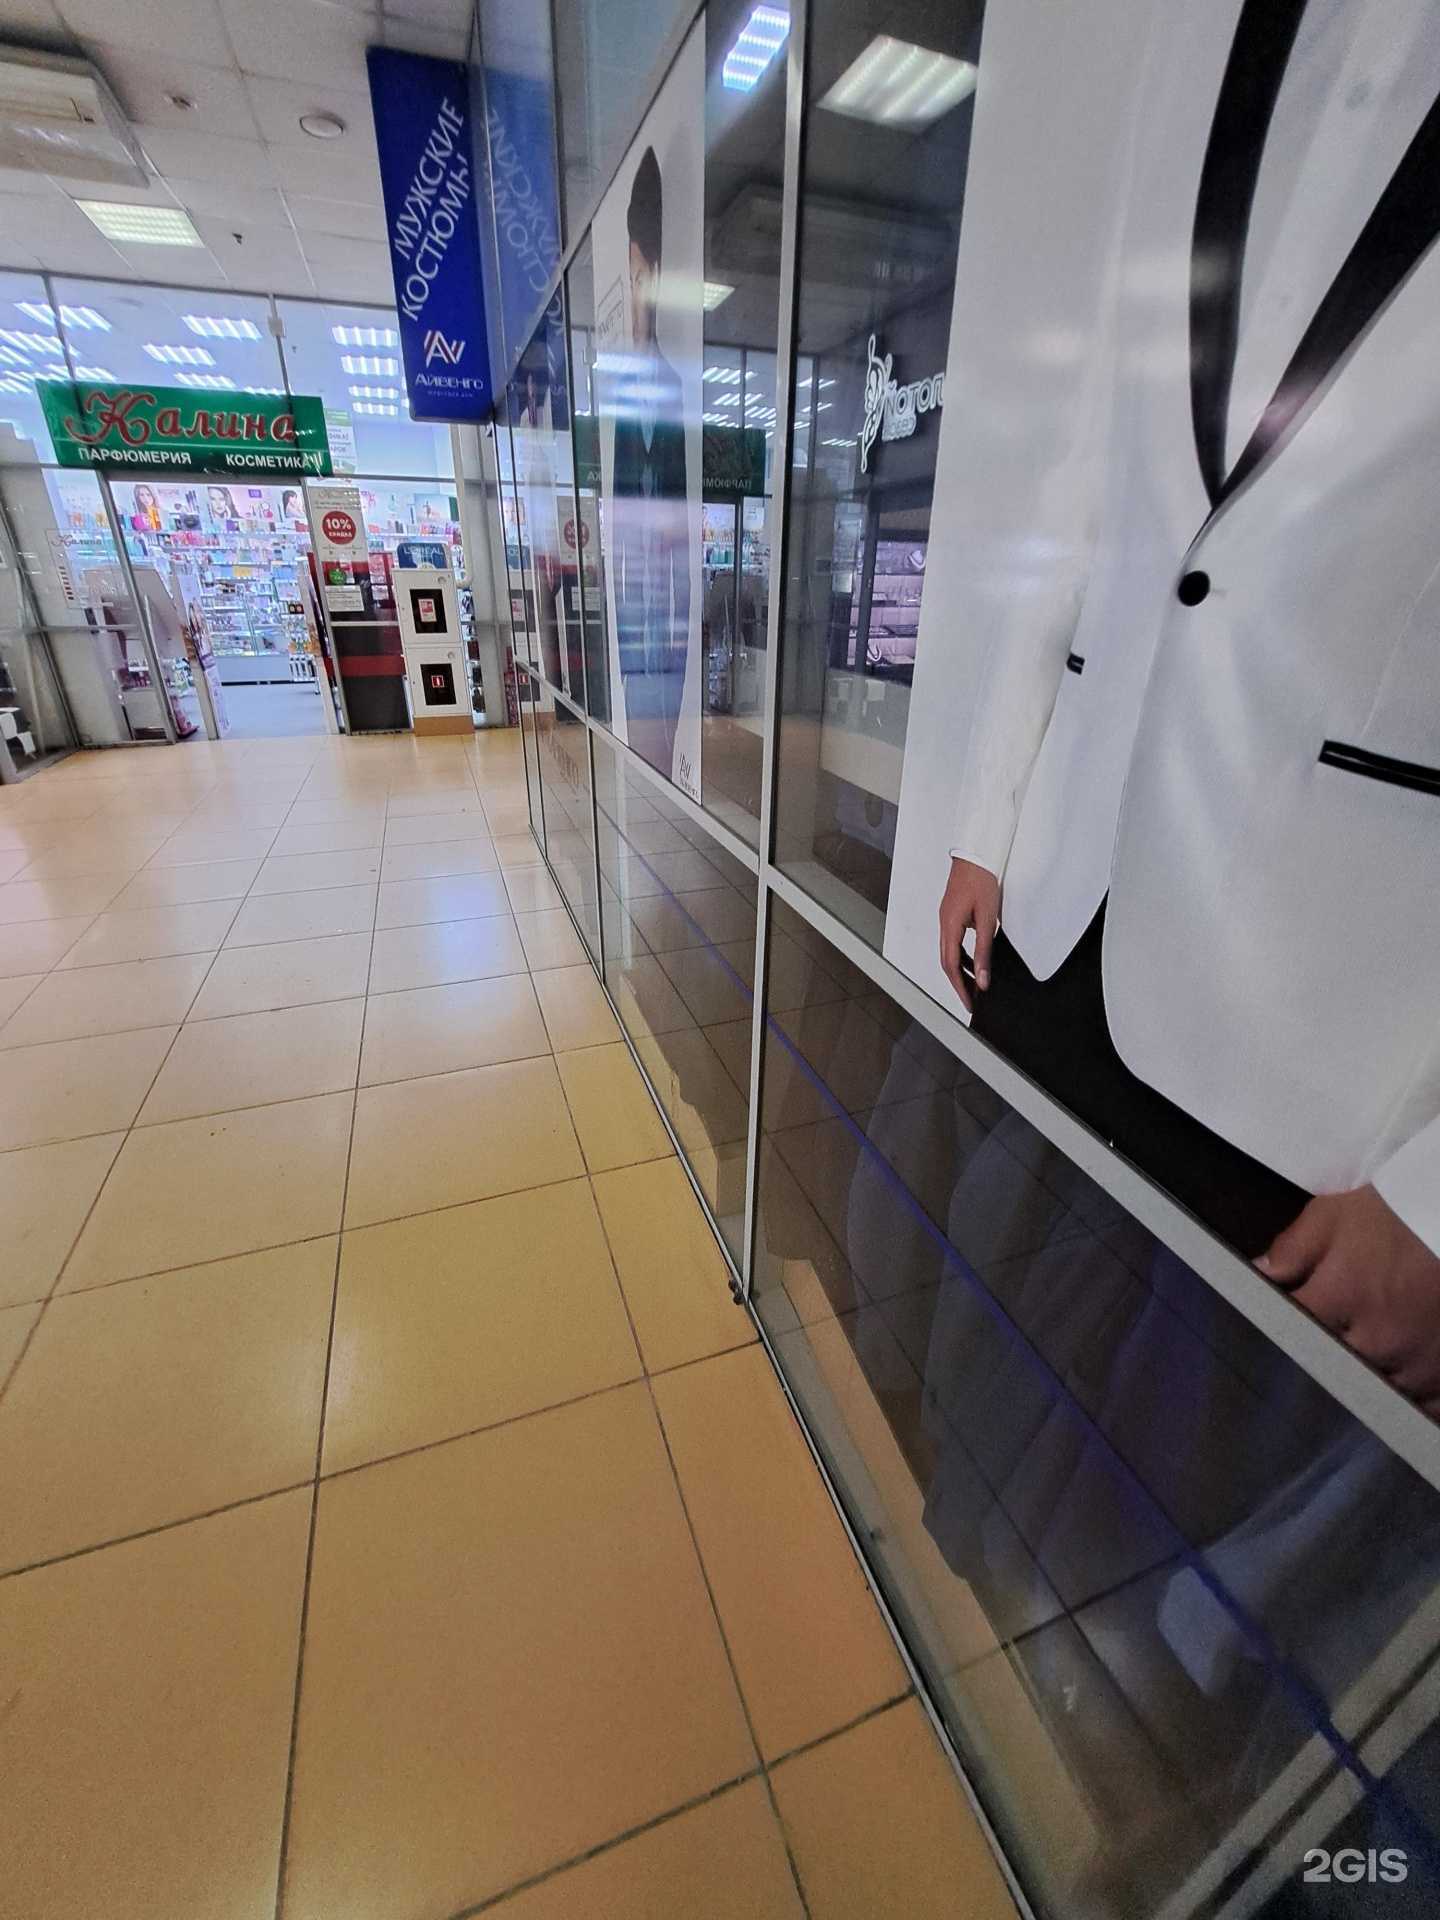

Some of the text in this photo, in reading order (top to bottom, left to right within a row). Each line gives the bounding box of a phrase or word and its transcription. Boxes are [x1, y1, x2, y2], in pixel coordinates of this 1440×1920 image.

[394, 98, 464, 260] МУЖСКИЕ
[402, 153, 470, 322] КОСТЮМЫ
[64, 389, 298, 447] Калина
[78, 446, 311, 469] ПАРФЮМЕРИЯ КОСМЕТИКА
[325, 517, 352, 531] 10%
